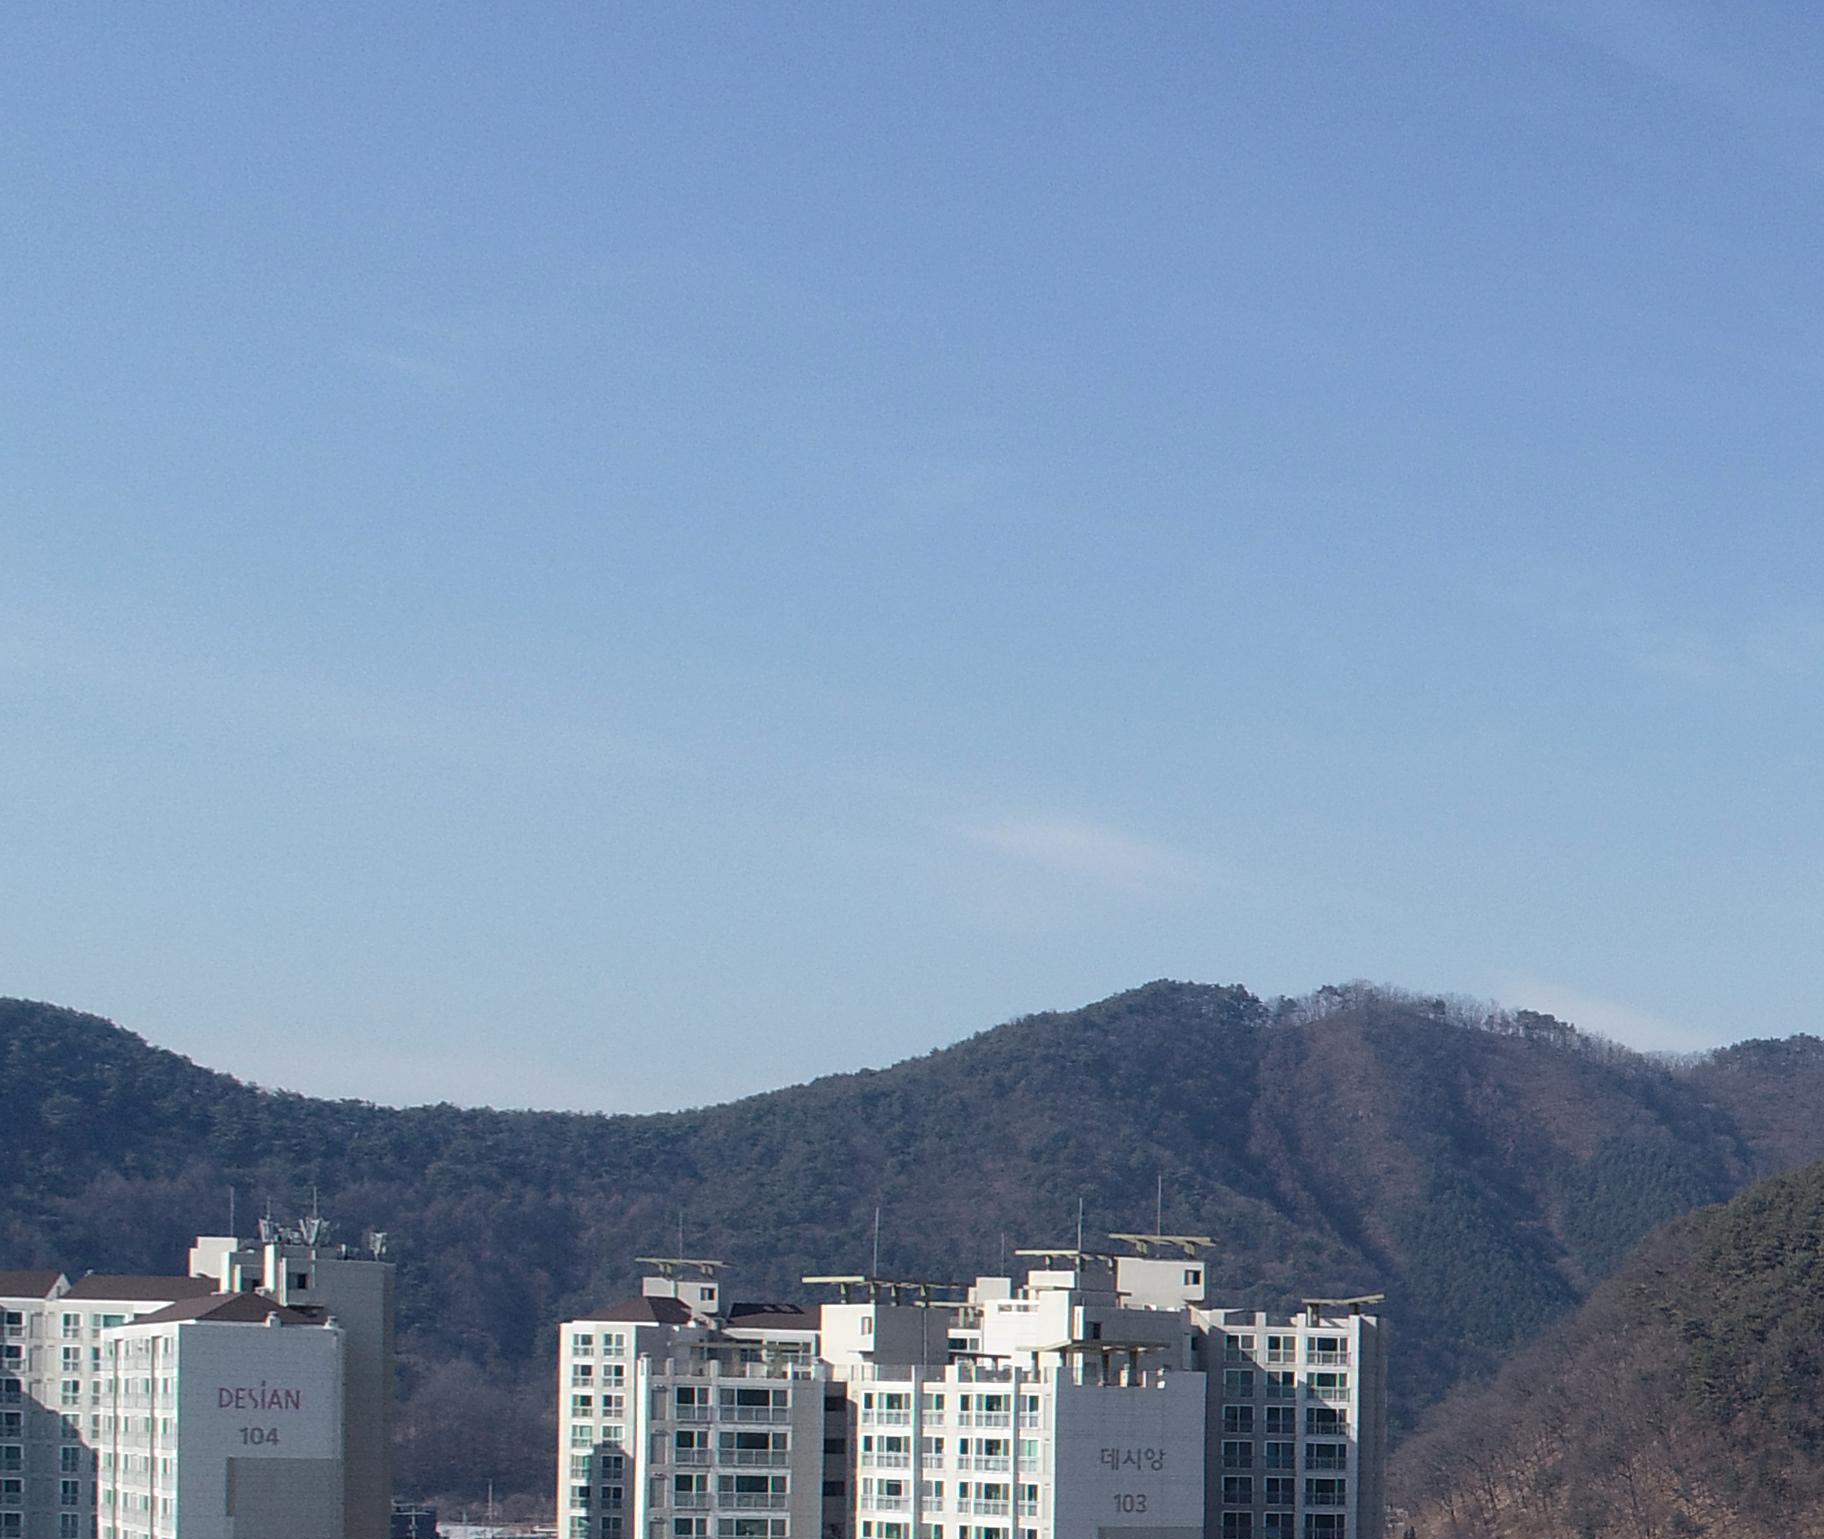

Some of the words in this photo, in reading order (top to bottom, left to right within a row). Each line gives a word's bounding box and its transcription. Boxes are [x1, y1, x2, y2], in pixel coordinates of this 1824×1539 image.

[240, 1427, 279, 1446] 104
[1100, 1448, 1166, 1471] 데시앙
[1113, 1494, 1147, 1513] 103
